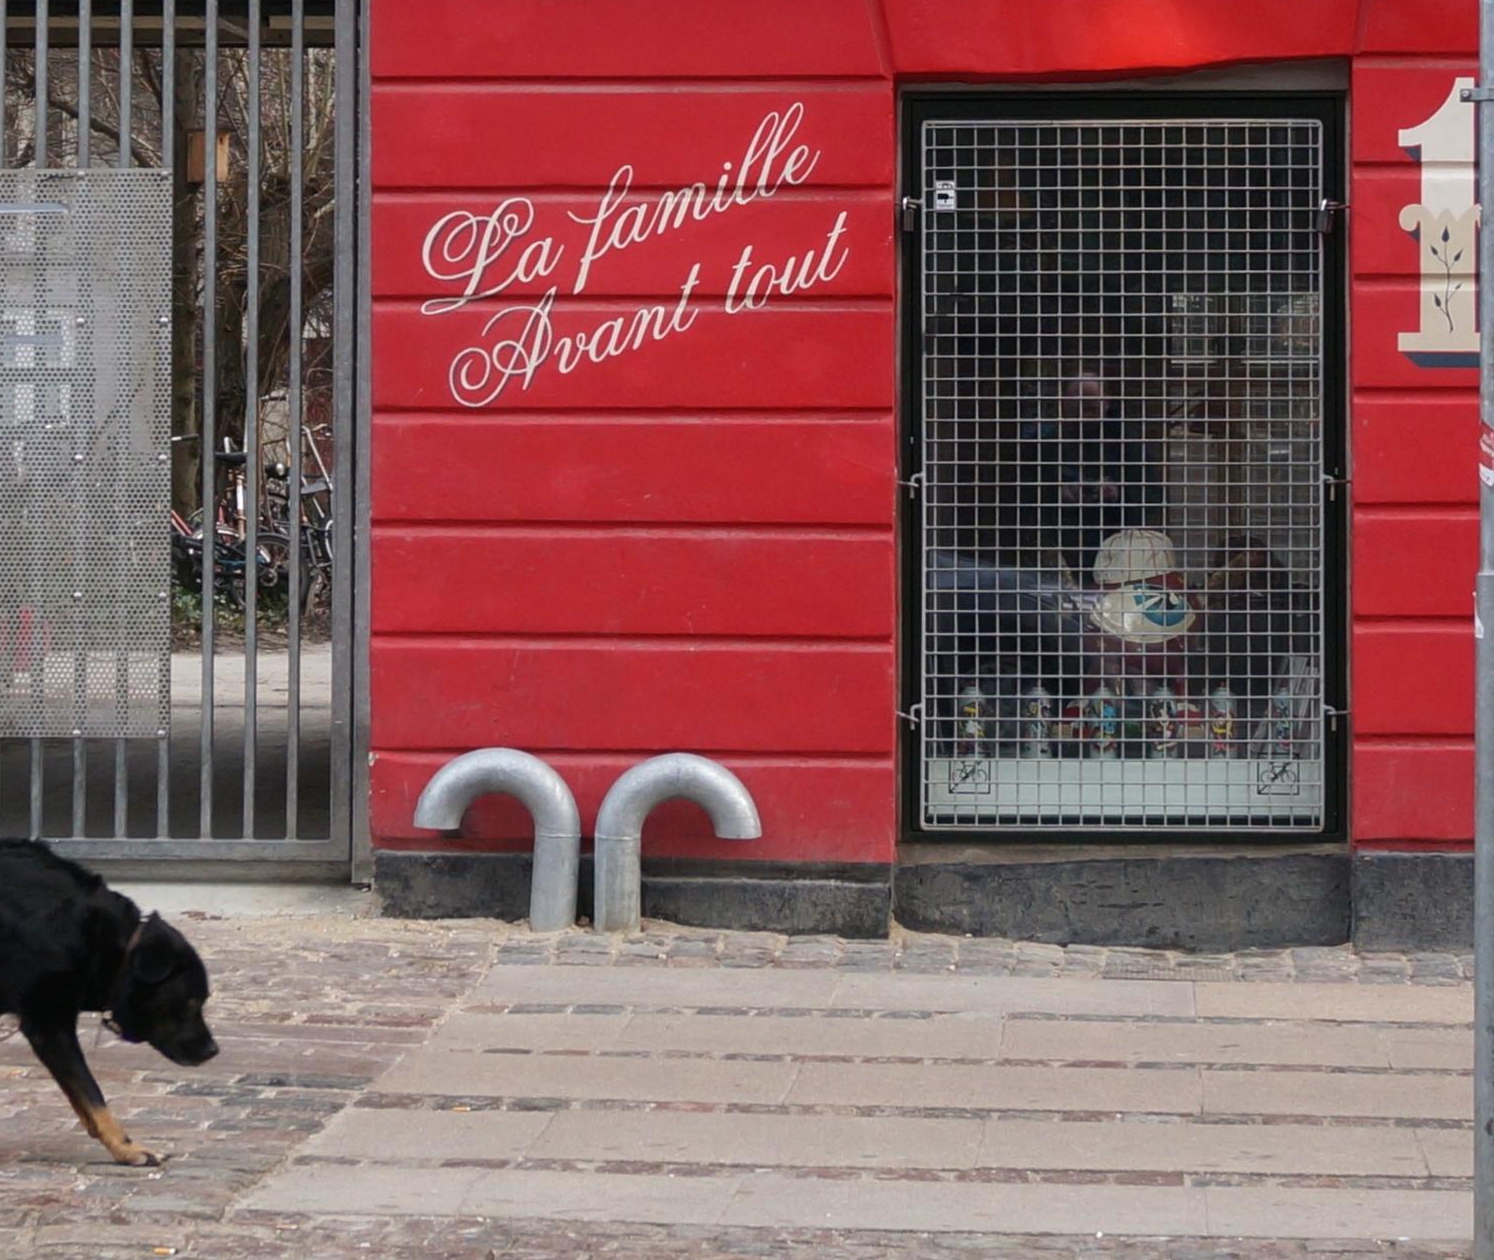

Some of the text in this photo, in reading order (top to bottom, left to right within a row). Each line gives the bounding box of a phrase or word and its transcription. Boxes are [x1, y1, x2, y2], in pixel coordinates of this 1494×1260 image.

[420, 101, 821, 315] La famille
[449, 211, 849, 408] Avant tout
